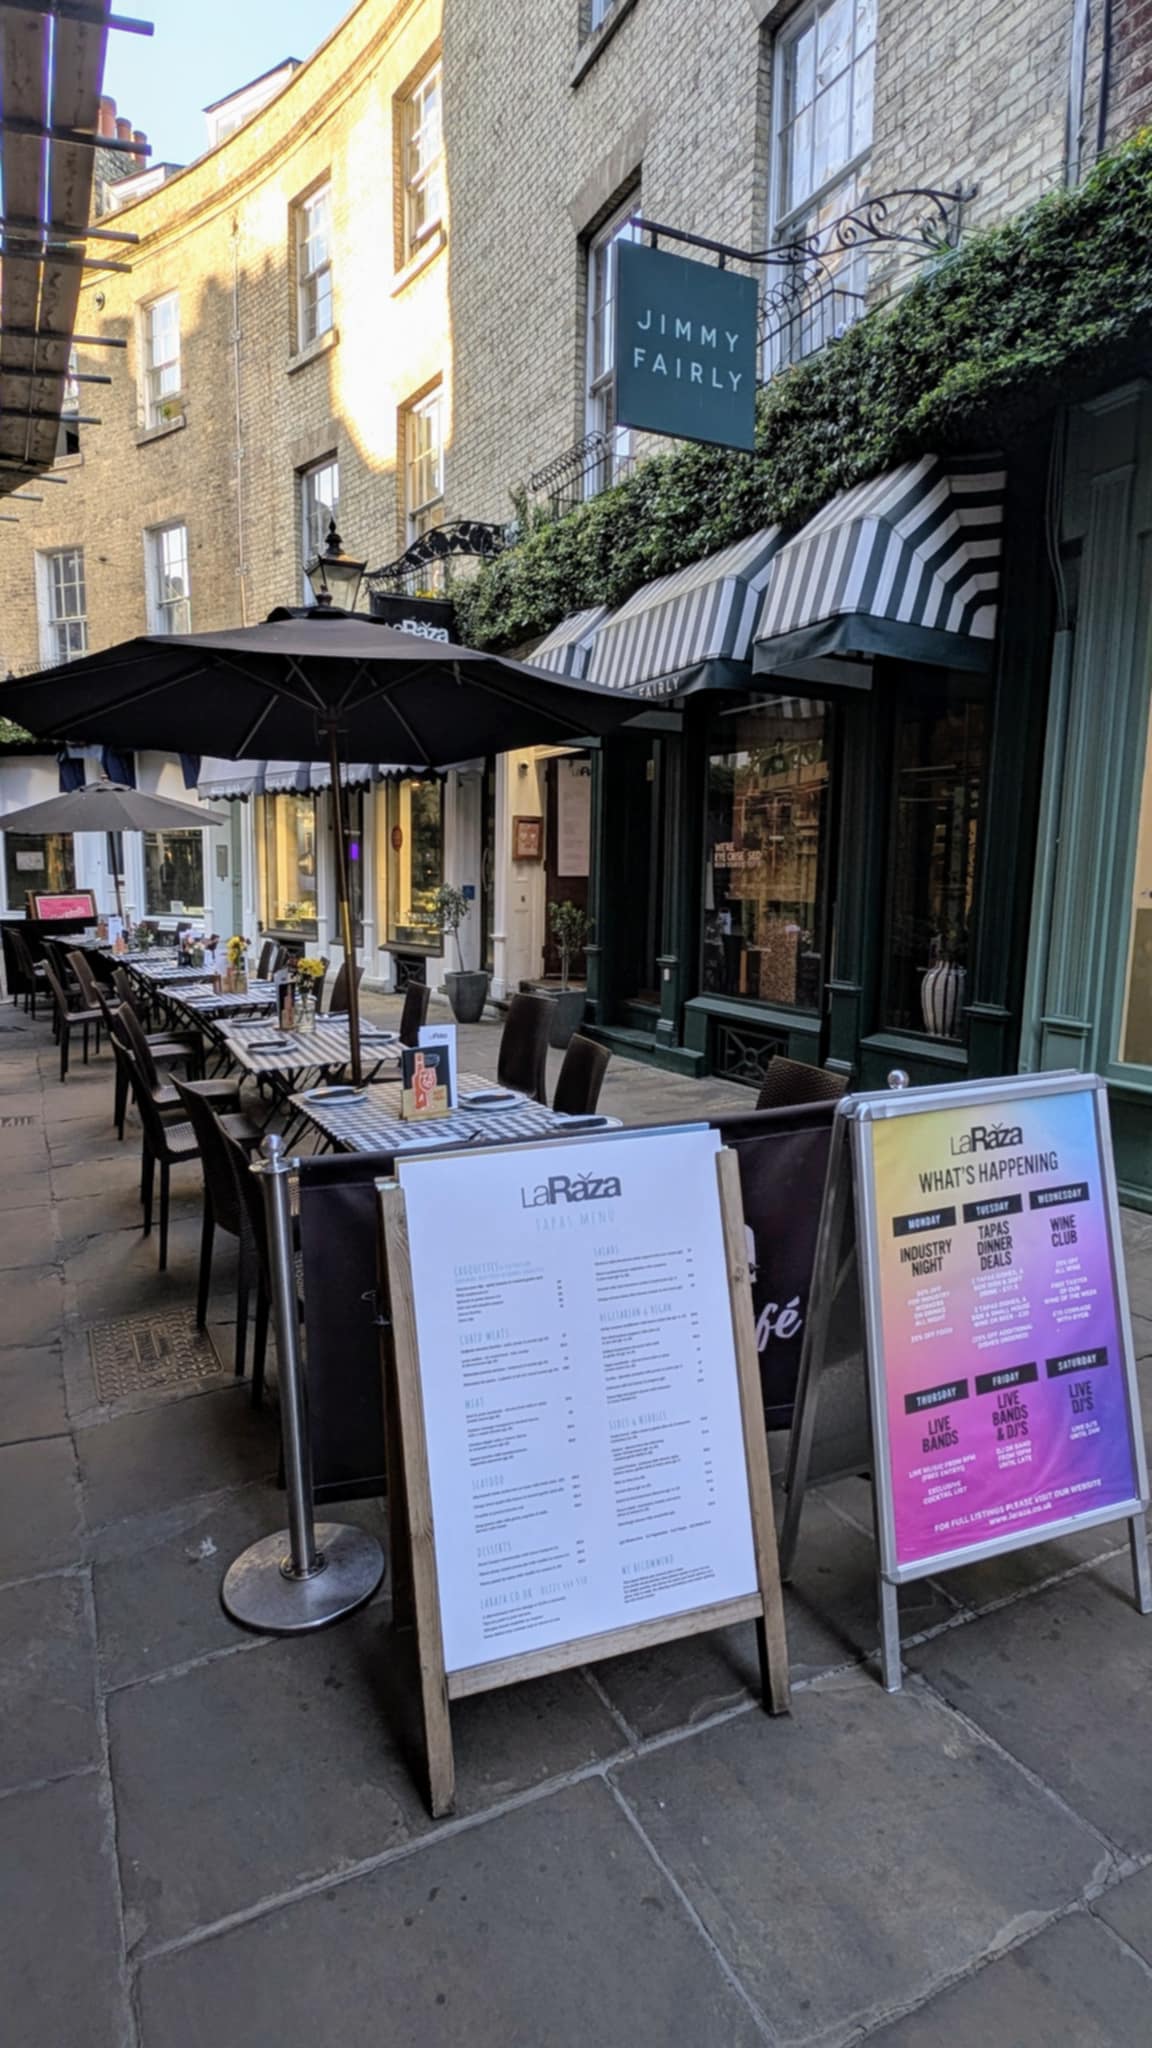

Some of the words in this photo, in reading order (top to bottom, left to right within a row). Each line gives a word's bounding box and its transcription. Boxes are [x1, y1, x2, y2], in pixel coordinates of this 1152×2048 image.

[637, 309, 739, 352] JIMMY
[633, 347, 742, 392] FAIRLY
[919, 1165, 976, 1194] WHAT'S
[979, 1151, 1059, 1183] HAPPENING
[908, 1214, 941, 1230] MONDAY
[976, 1201, 1009, 1216] TUESDAY
[1037, 1188, 1082, 1204] WEDNESDAY
[978, 1221, 1010, 1239] TAPAS
[1050, 1215, 1077, 1232] WINE
[977, 1235, 1013, 1257] DINNER
[1051, 1230, 1078, 1248] CLUB
[900, 1238, 953, 1263] INDUSTRY
[980, 1251, 1012, 1271] DEALS
[911, 1256, 943, 1278] NIGHT
[916, 1387, 957, 1407] THURSDAY
[992, 1370, 1020, 1387] FRIDAY
[1057, 1353, 1097, 1371] SATURDAY
[1069, 1380, 1093, 1399] LIVE
[997, 1390, 1020, 1410] LIVE
[928, 1415, 951, 1436] LIVE
[992, 1404, 1029, 1427] BANDS
[922, 1430, 959, 1453] BANDS
[996, 1427, 1005, 1442] &
[934, 1520, 949, 1533] FOR
[950, 1514, 969, 1528] FULL
[969, 1503, 1004, 1523] LISTINGS
[1006, 1494, 1033, 1513] PLEASE
[1053, 1485, 1069, 1499] OUR
